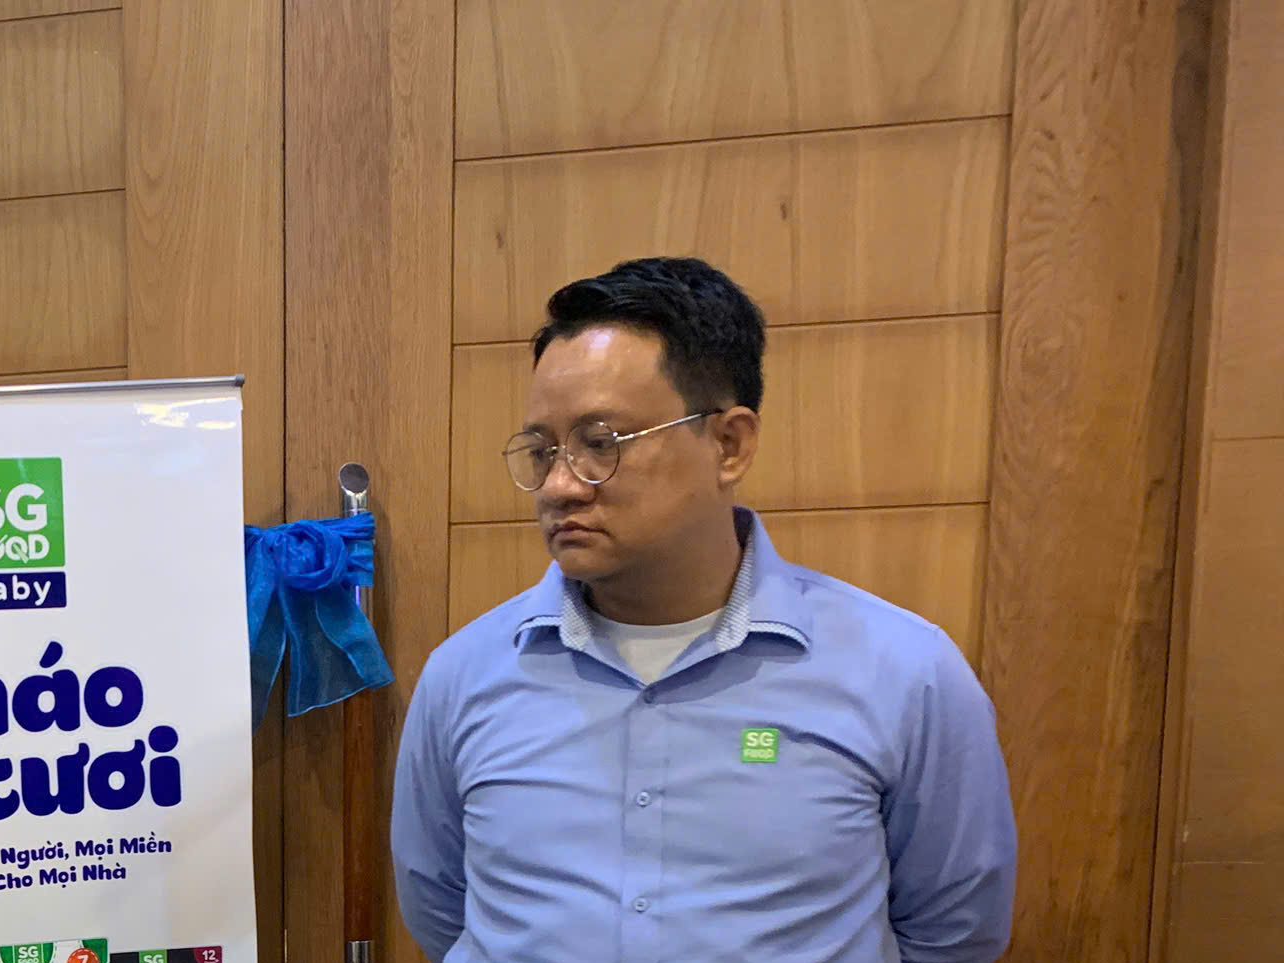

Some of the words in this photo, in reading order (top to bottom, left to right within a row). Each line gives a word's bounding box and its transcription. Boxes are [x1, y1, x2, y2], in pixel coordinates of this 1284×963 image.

[746, 732, 775, 747] SG
[0, 841, 69, 869] Người,
[75, 838, 114, 860] Mọi
[119, 831, 172, 854] Miền
[39, 866, 77, 888] Mọi
[83, 862, 126, 881] Nhà
[18, 946, 39, 958] SG
[202, 950, 216, 961] 12
